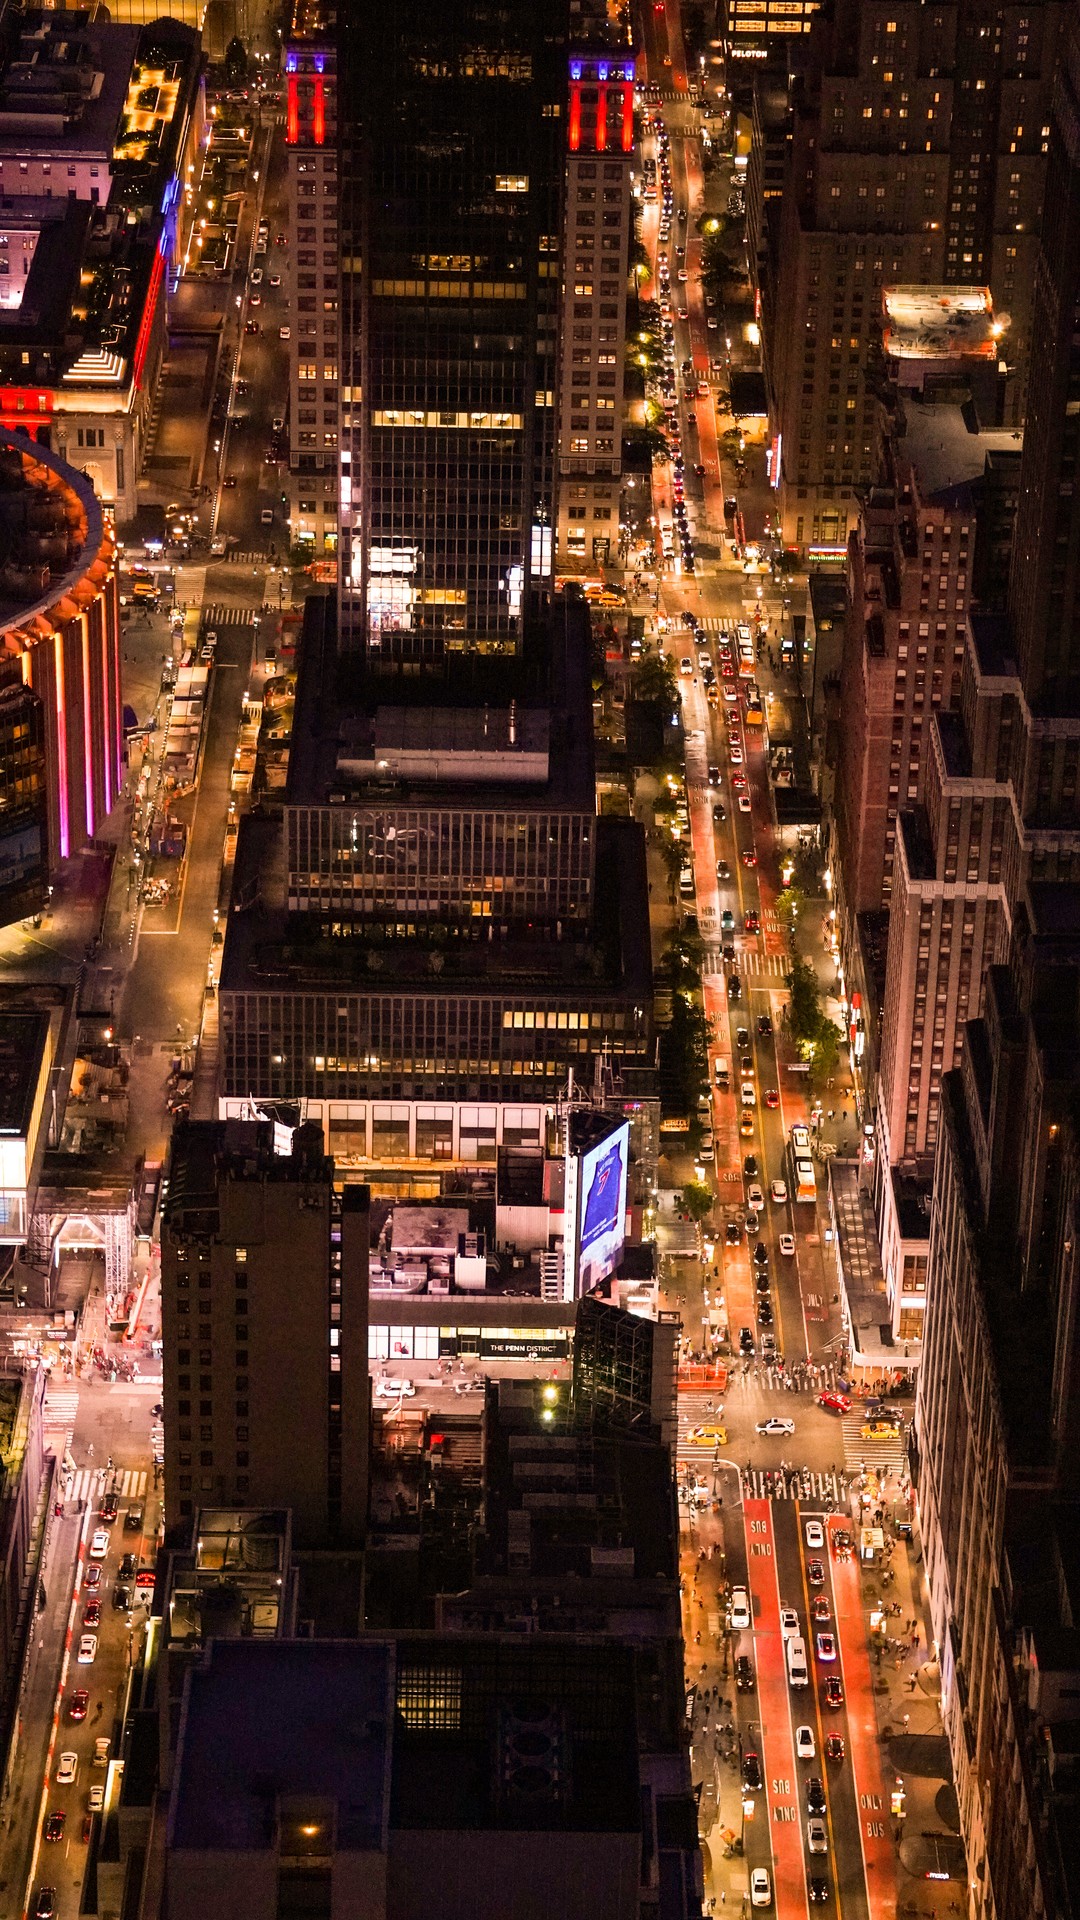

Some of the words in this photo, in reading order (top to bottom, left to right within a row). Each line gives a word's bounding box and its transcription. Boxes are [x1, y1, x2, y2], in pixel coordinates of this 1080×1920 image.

[731, 50, 768, 58] PELOTON
[766, 923, 780, 932] BUS
[597, 1168, 610, 1196] 7
[490, 1344, 504, 1352] THE
[751, 1520, 767, 1533] BUS
[750, 1543, 772, 1557] ONLY
[772, 1779, 791, 1794] BUS
[860, 1794, 883, 1810] ONLY
[773, 1806, 796, 1821] ONLY
[866, 1822, 885, 1838] BUS
